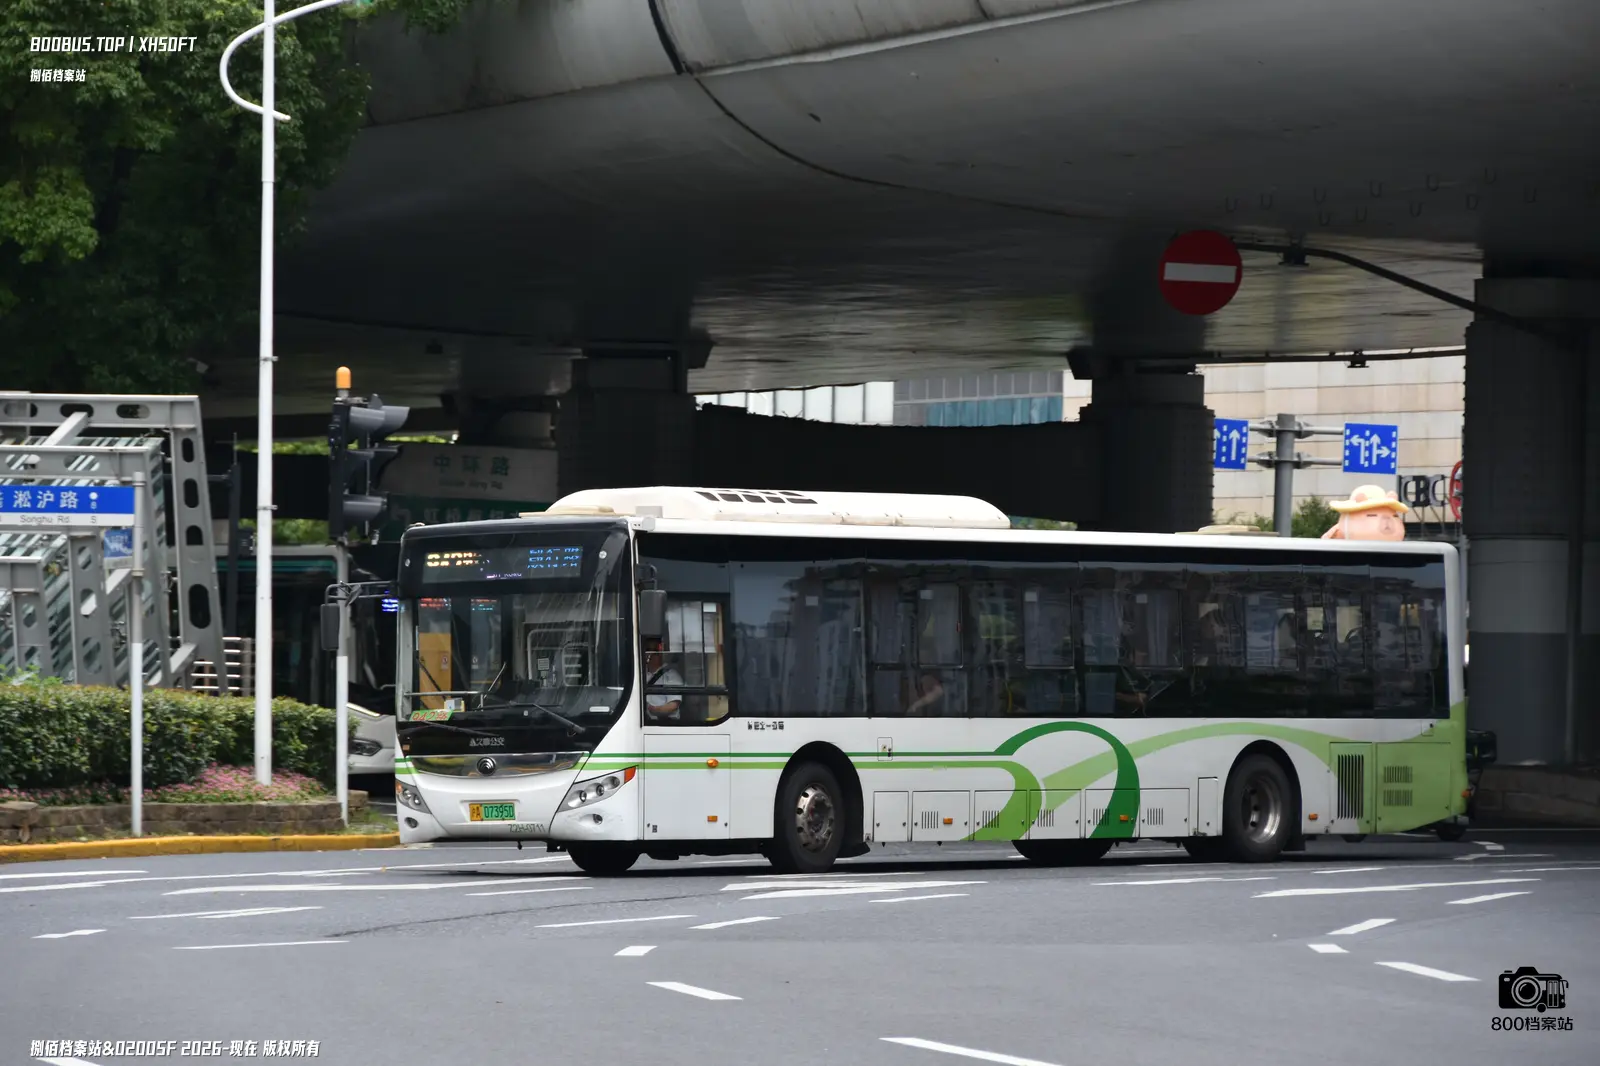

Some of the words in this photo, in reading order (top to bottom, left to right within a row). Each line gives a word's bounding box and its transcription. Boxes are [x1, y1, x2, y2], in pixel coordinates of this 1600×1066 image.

[13, 490, 78, 508] 淞沪路
[20, 515, 53, 525] Songhu
[476, 736, 505, 747] 久公交
